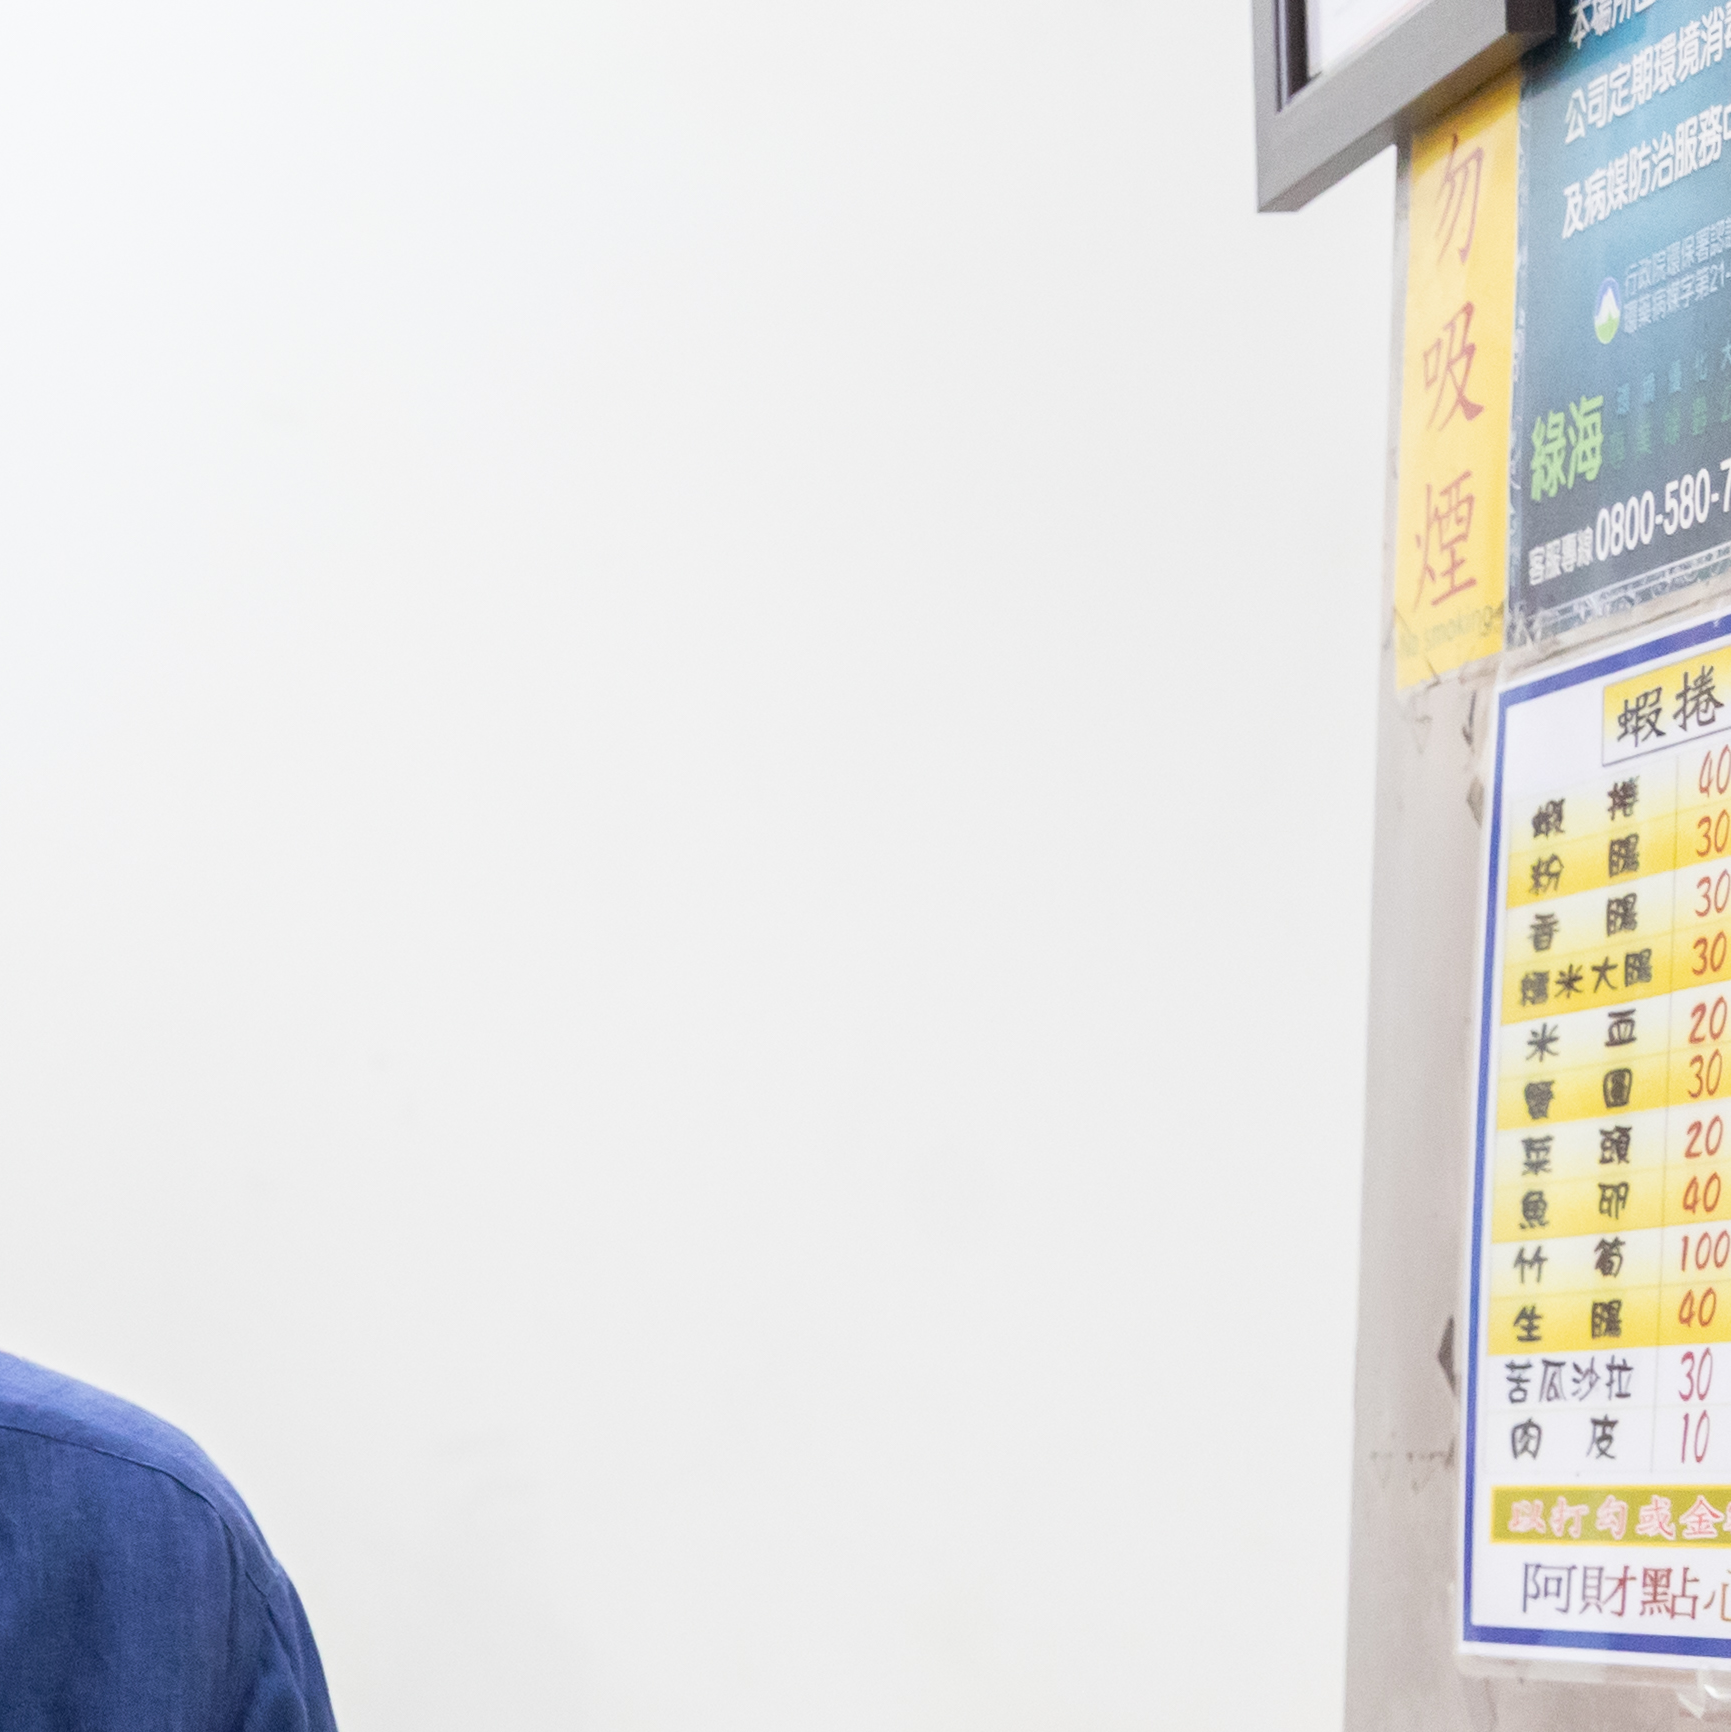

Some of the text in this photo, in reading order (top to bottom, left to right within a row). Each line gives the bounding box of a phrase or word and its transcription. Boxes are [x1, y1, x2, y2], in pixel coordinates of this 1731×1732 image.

[1565, 1, 1731, 145] 公司定期環境消
[1561, 103, 1731, 239] 及病媒防治服務
[1412, 132, 1485, 613] 勿吸煙
[1531, 395, 1604, 501] 綠海
[1617, 665, 1724, 748] 蝦捲
[1699, 744, 1731, 797] 40
[1696, 809, 1731, 857] 30
[1695, 869, 1731, 917] 30
[1692, 930, 1727, 976] 30
[1688, 996, 1728, 1044] 20
[1687, 1048, 1723, 1099] 30
[1684, 1114, 1724, 1159] 20
[1682, 1171, 1721, 1214] 40
[1681, 1229, 1731, 1272] 100
[1678, 1286, 1717, 1327] 40
[1505, 1347, 1713, 1404] 苦瓜沙拉 30
[1511, 1409, 1710, 1464] 肉皮 10
[1508, 1494, 1731, 1540] 以打勾或金
